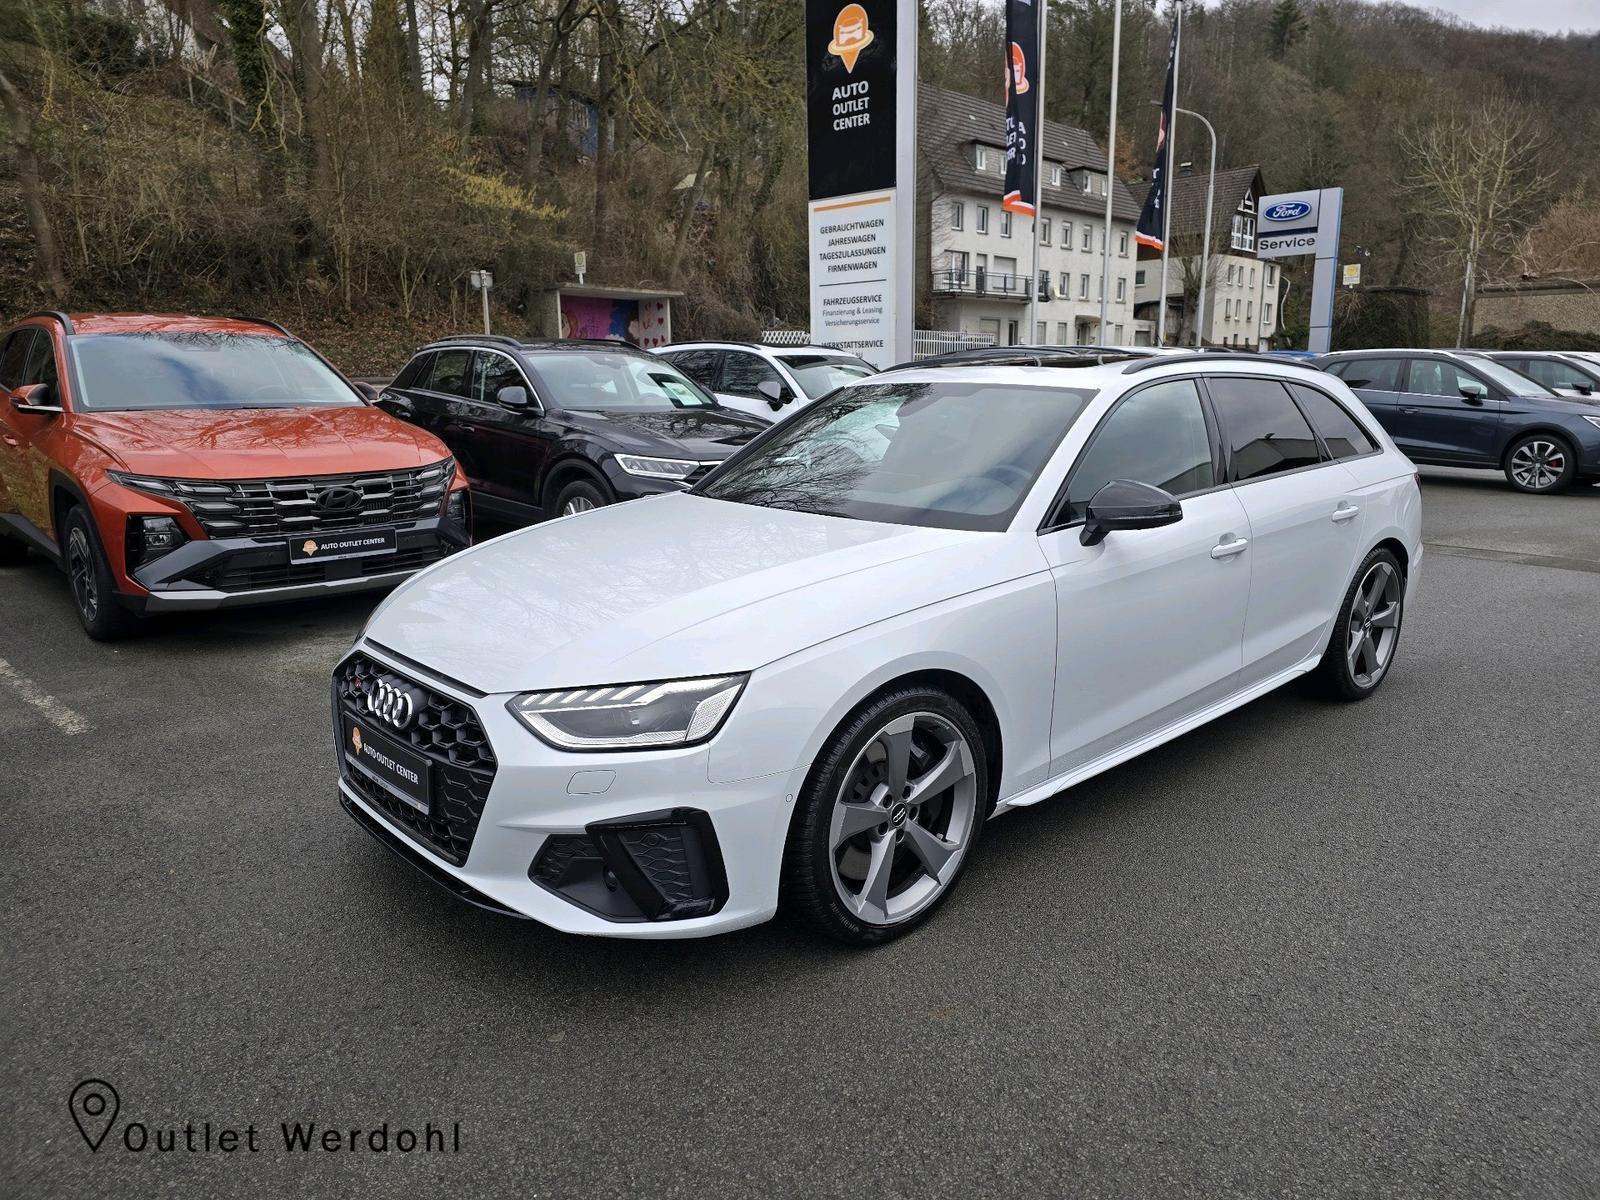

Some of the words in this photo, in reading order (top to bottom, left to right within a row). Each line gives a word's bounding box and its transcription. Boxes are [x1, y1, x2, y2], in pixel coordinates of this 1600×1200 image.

[832, 80, 869, 101] AUTO
[832, 97, 870, 116] OUTLET
[833, 113, 870, 131] CENTER
[819, 219, 884, 234] GEBRAUCHTWAGEN
[828, 233, 876, 247] JAHRESWAGEN
[1259, 237, 1316, 250] Service
[819, 246, 886, 261] TAGESZULASSUNGEN
[827, 260, 878, 273] FIRMENWAGEN
[823, 294, 882, 306] FAHRZEUGSERVICE
[822, 308, 855, 317] Finanzierung
[862, 306, 883, 315] Leasing
[339, 540, 362, 548] OUTLET
[363, 537, 385, 545] CENTER
[363, 742, 376, 759] AUTO
[376, 751, 397, 772] OUTLET
[397, 763, 419, 785] CENTER
